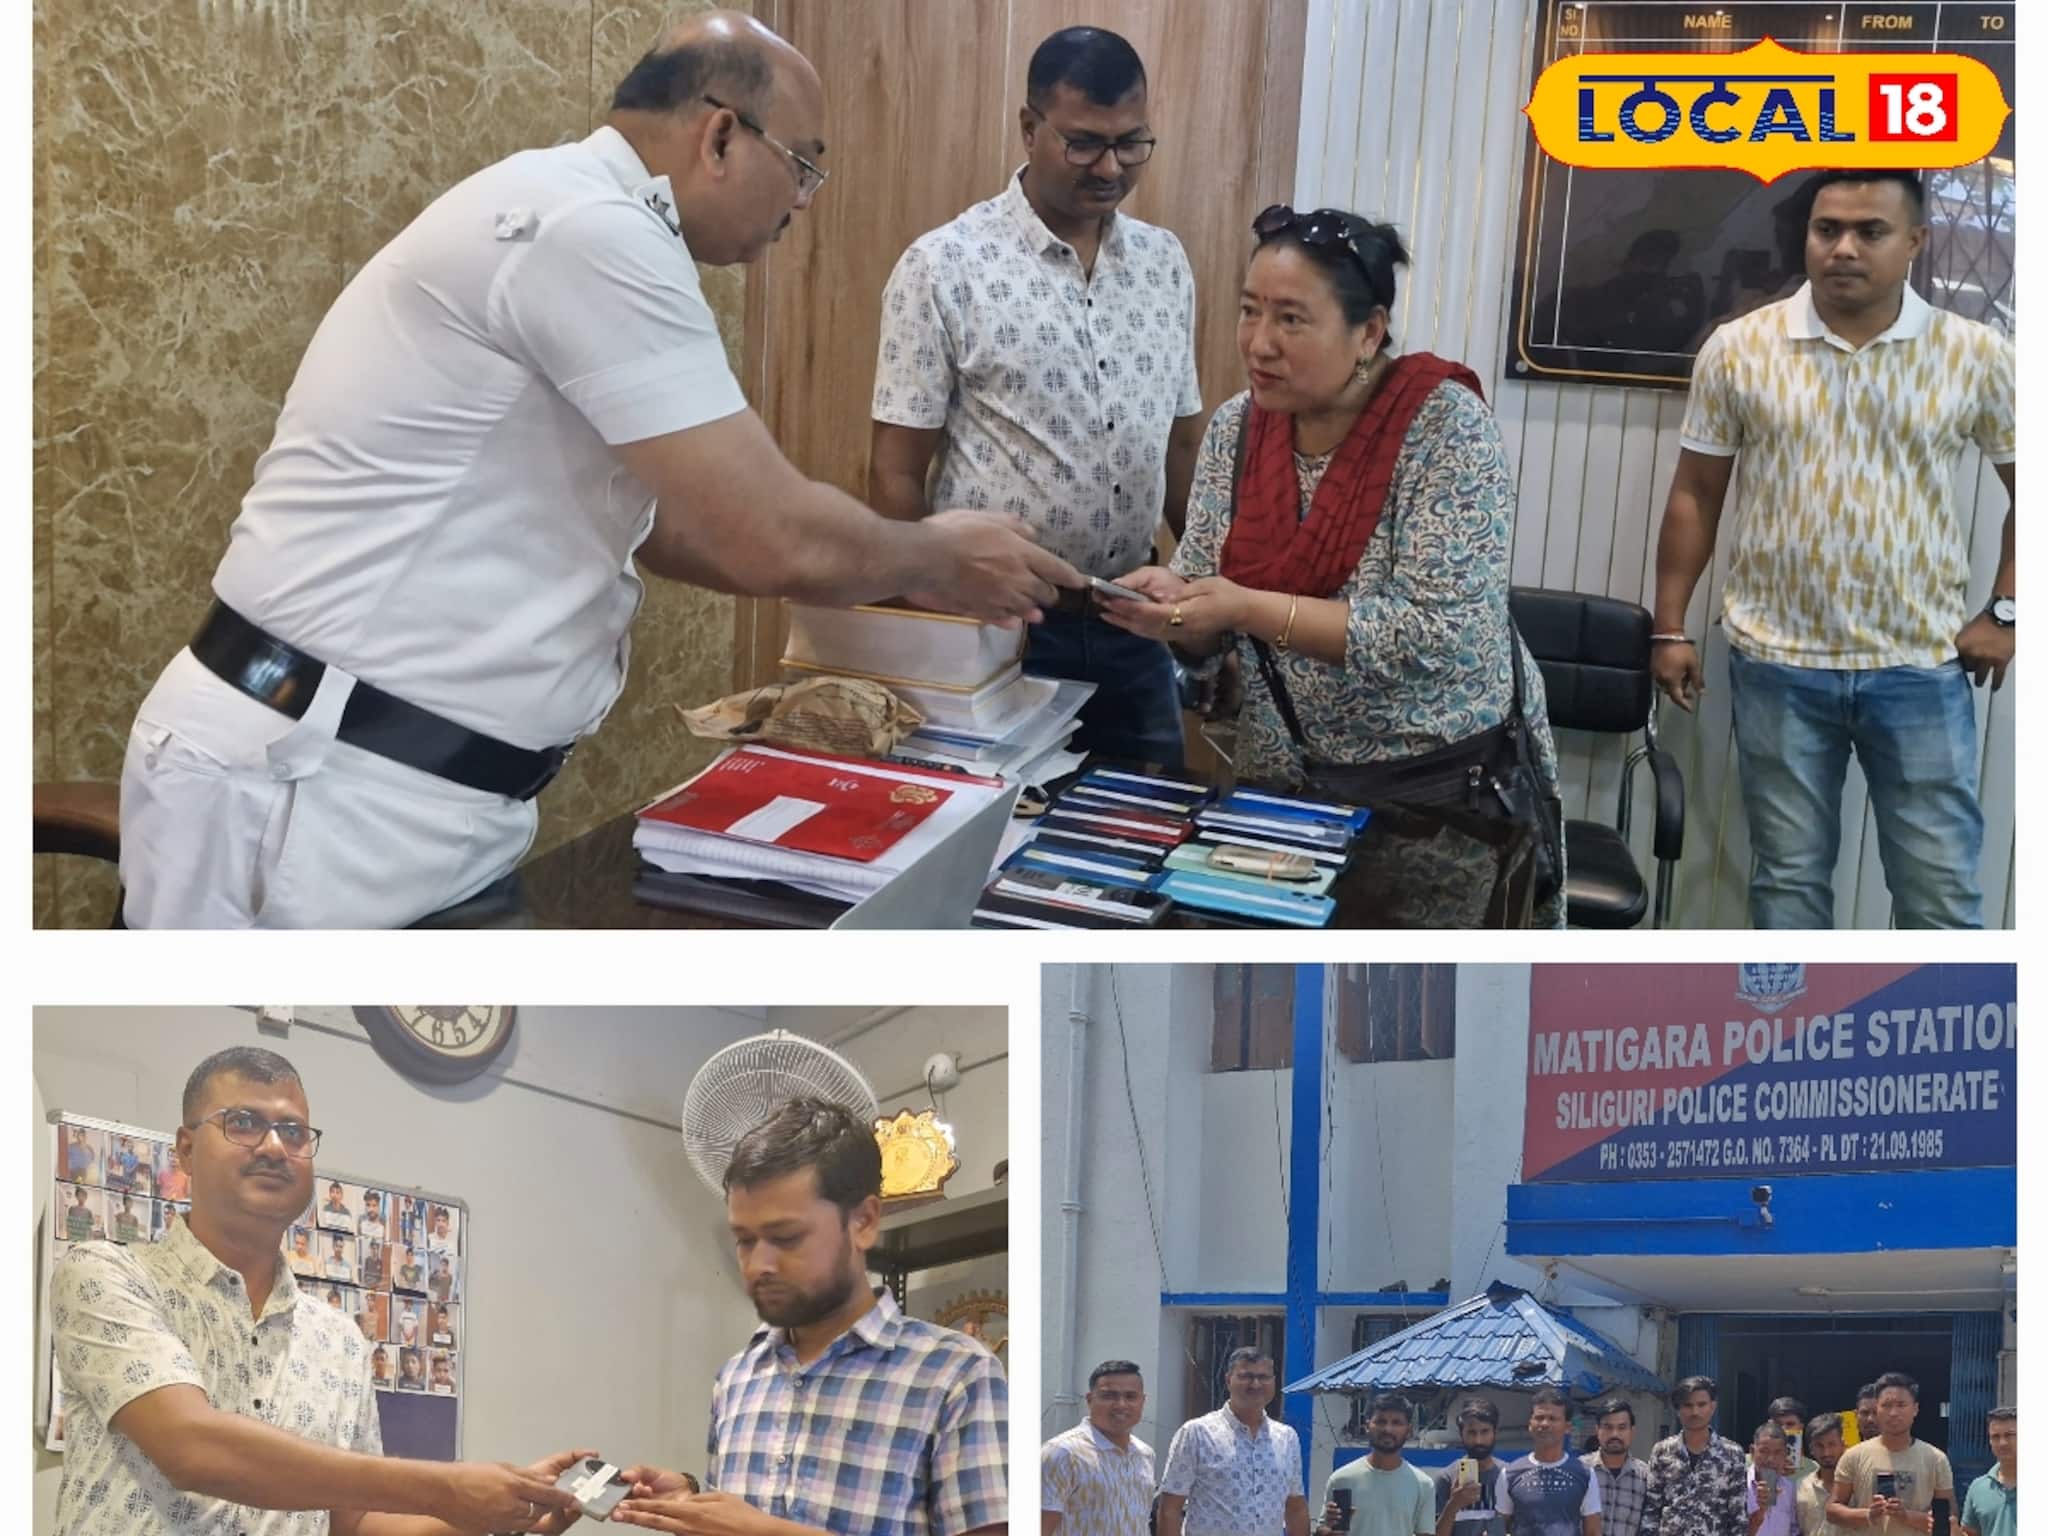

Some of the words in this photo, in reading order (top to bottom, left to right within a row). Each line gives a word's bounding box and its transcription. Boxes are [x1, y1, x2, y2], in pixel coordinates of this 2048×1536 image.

[1683, 14, 1733, 29] NAME
[1861, 15, 1913, 29] FROM
[1979, 15, 2006, 30] TO
[1533, 1023, 1712, 1075] MATIGARA
[1723, 1012, 1855, 1066] POLICE
[1556, 1087, 1656, 1129] SILIGURI
[1663, 1083, 1748, 1126] POLICE
[1754, 1069, 2000, 1121] COMMISSIONERATE
[1600, 1143, 1618, 1170] PH
[1627, 1141, 1657, 1169] 0353
[1667, 1138, 1720, 1169] 2571472
[1723, 1137, 1749, 1166] G.O.
[1752, 1136, 1775, 1166] NO.
[1779, 1134, 1810, 1164] 7364
[1820, 1134, 1837, 1162] PL
[1841, 1133, 1859, 1161] DT
[1870, 1129, 1944, 1161] 21.09.1985
